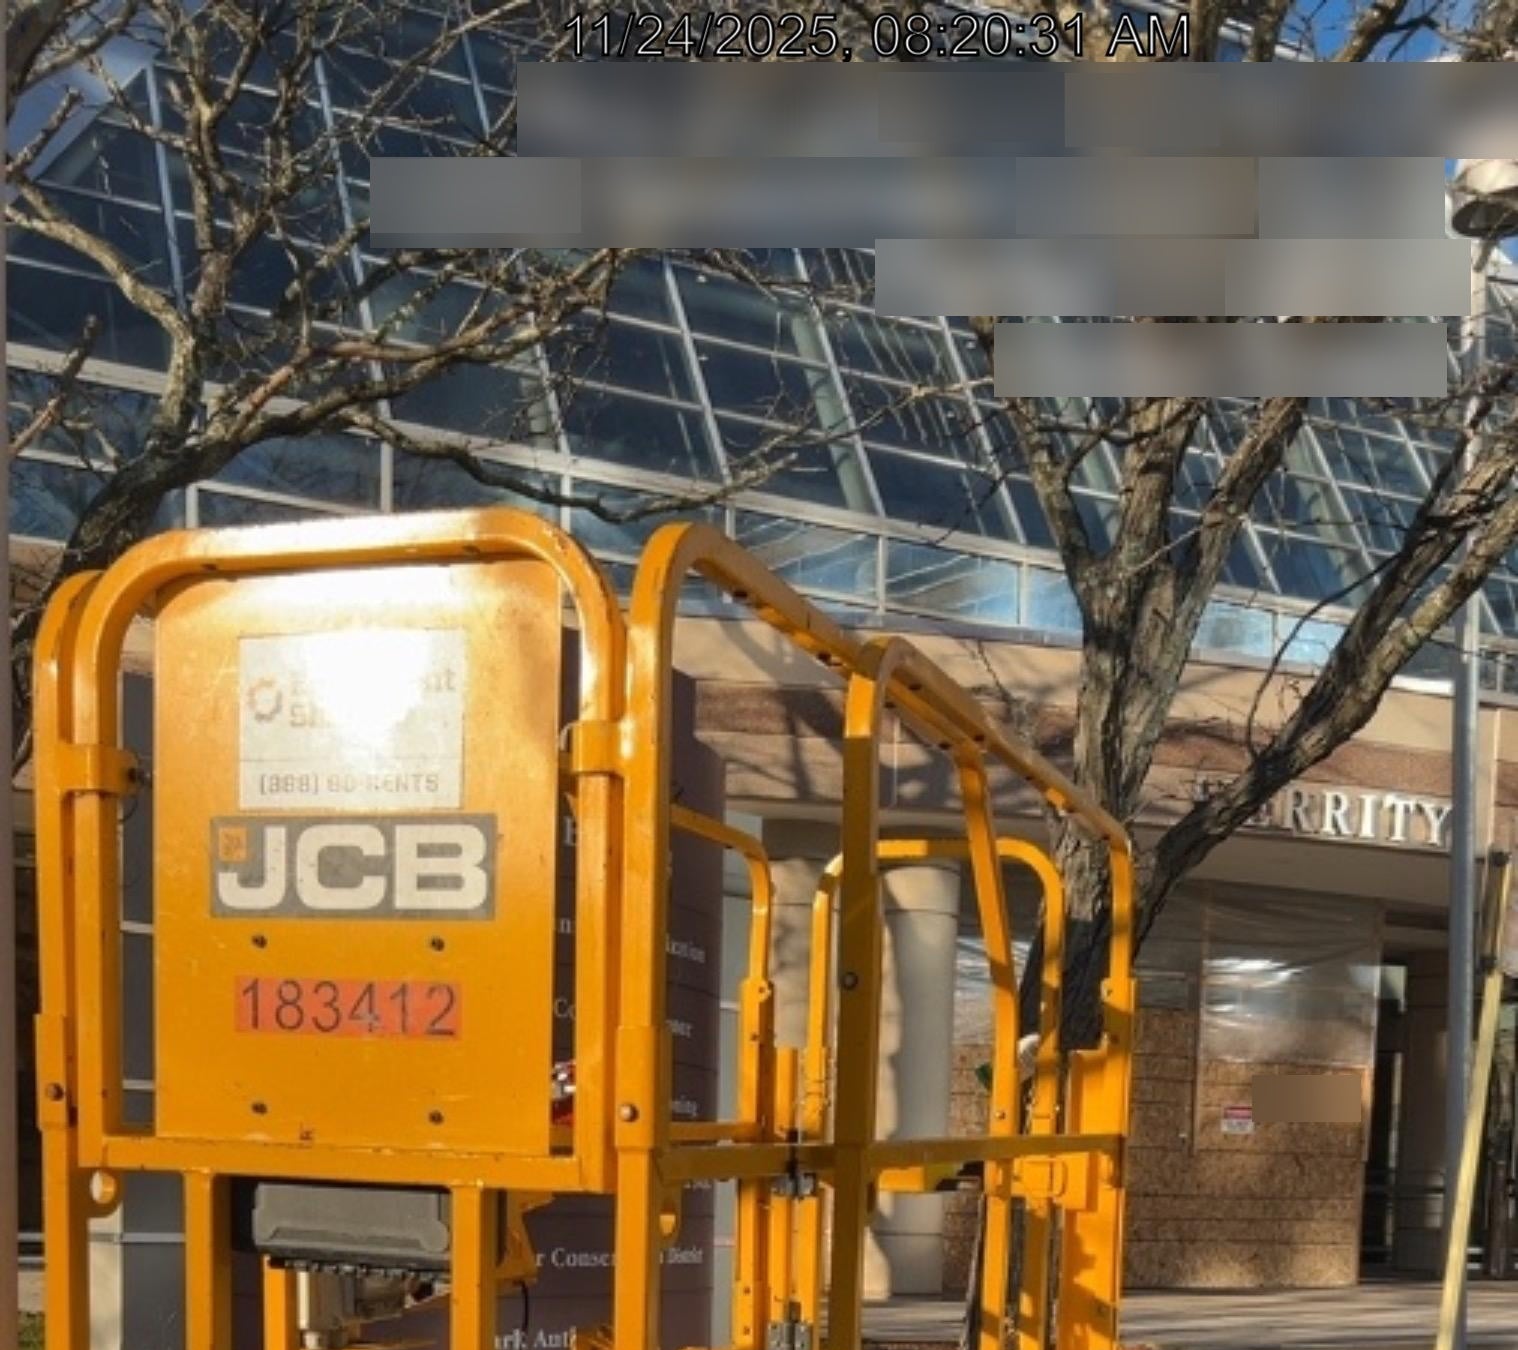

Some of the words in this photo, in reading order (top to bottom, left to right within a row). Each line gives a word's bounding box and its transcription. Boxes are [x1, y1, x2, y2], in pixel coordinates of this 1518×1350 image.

[1240, 780, 1453, 847] RRITY
[217, 823, 489, 911] JCB
[240, 976, 457, 1037] 183412
